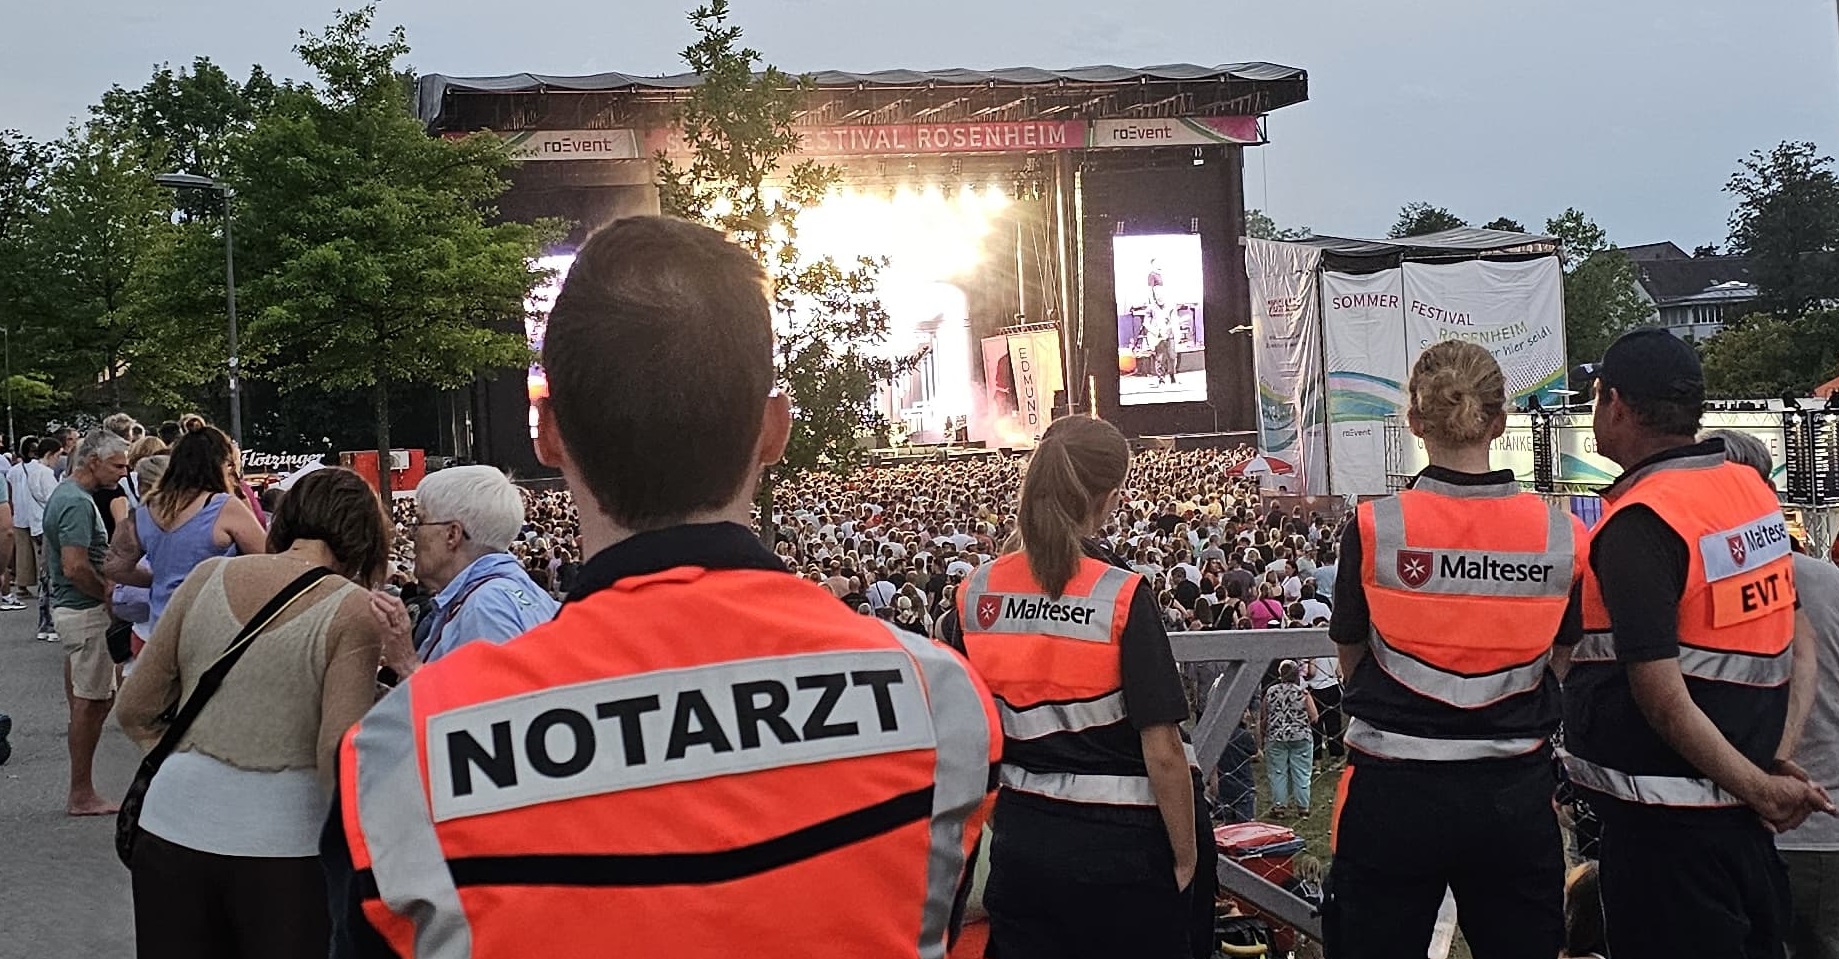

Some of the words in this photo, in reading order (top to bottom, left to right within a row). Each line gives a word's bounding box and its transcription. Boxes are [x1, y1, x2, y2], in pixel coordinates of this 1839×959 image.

[544, 138, 612, 153] roEvent
[801, 128, 905, 151] ESTIVAL
[917, 124, 1066, 148] ROSENHEIM
[1113, 125, 1172, 140] roEvent
[1332, 294, 1399, 310] SOMMER
[1410, 300, 1475, 326] FESTIVAL
[1439, 320, 1528, 343] ROSENHEIM
[1018, 347, 1038, 425] EDMUND
[1490, 431, 1533, 452] TRÄNKE
[1744, 522, 1787, 554] Maltese
[1440, 554, 1554, 583] Malteser
[1741, 573, 1779, 613] EVT
[1005, 597, 1096, 625] Malteser
[446, 668, 904, 798] NOTARZT
